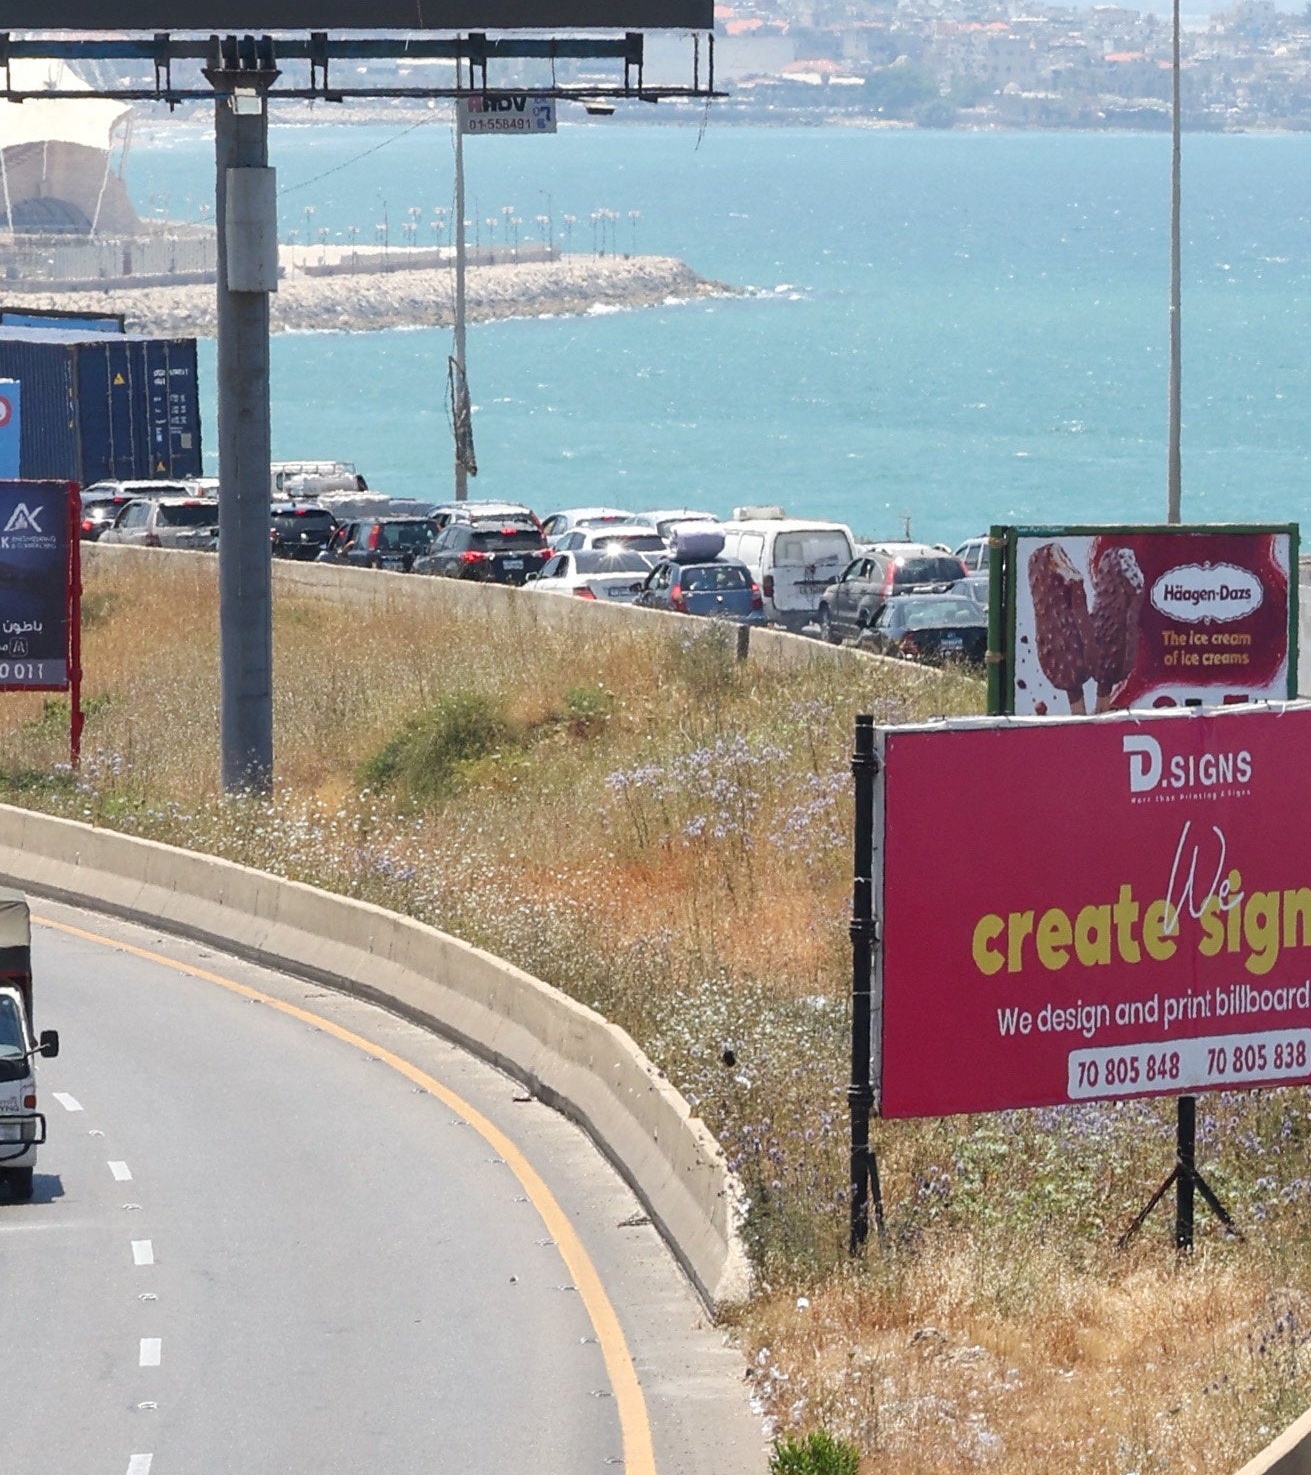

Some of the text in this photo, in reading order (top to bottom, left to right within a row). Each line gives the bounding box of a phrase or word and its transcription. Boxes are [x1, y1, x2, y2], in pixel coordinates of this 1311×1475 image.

[1163, 584, 1252, 606] Häagen-Dazs
[1162, 629, 1251, 645] The ice cream
[1164, 649, 1250, 664] of ice creams
[1122, 734, 1253, 793] D.SIGNS
[1163, 821, 1244, 936] We
[971, 883, 1179, 976] create
[997, 1007, 1032, 1037] We
[1037, 998, 1110, 1039] design
[1116, 993, 1159, 1026] and
[1163, 988, 1211, 1030] print
[1078, 1039, 1307, 1088] 70 805 848 70 805 838
